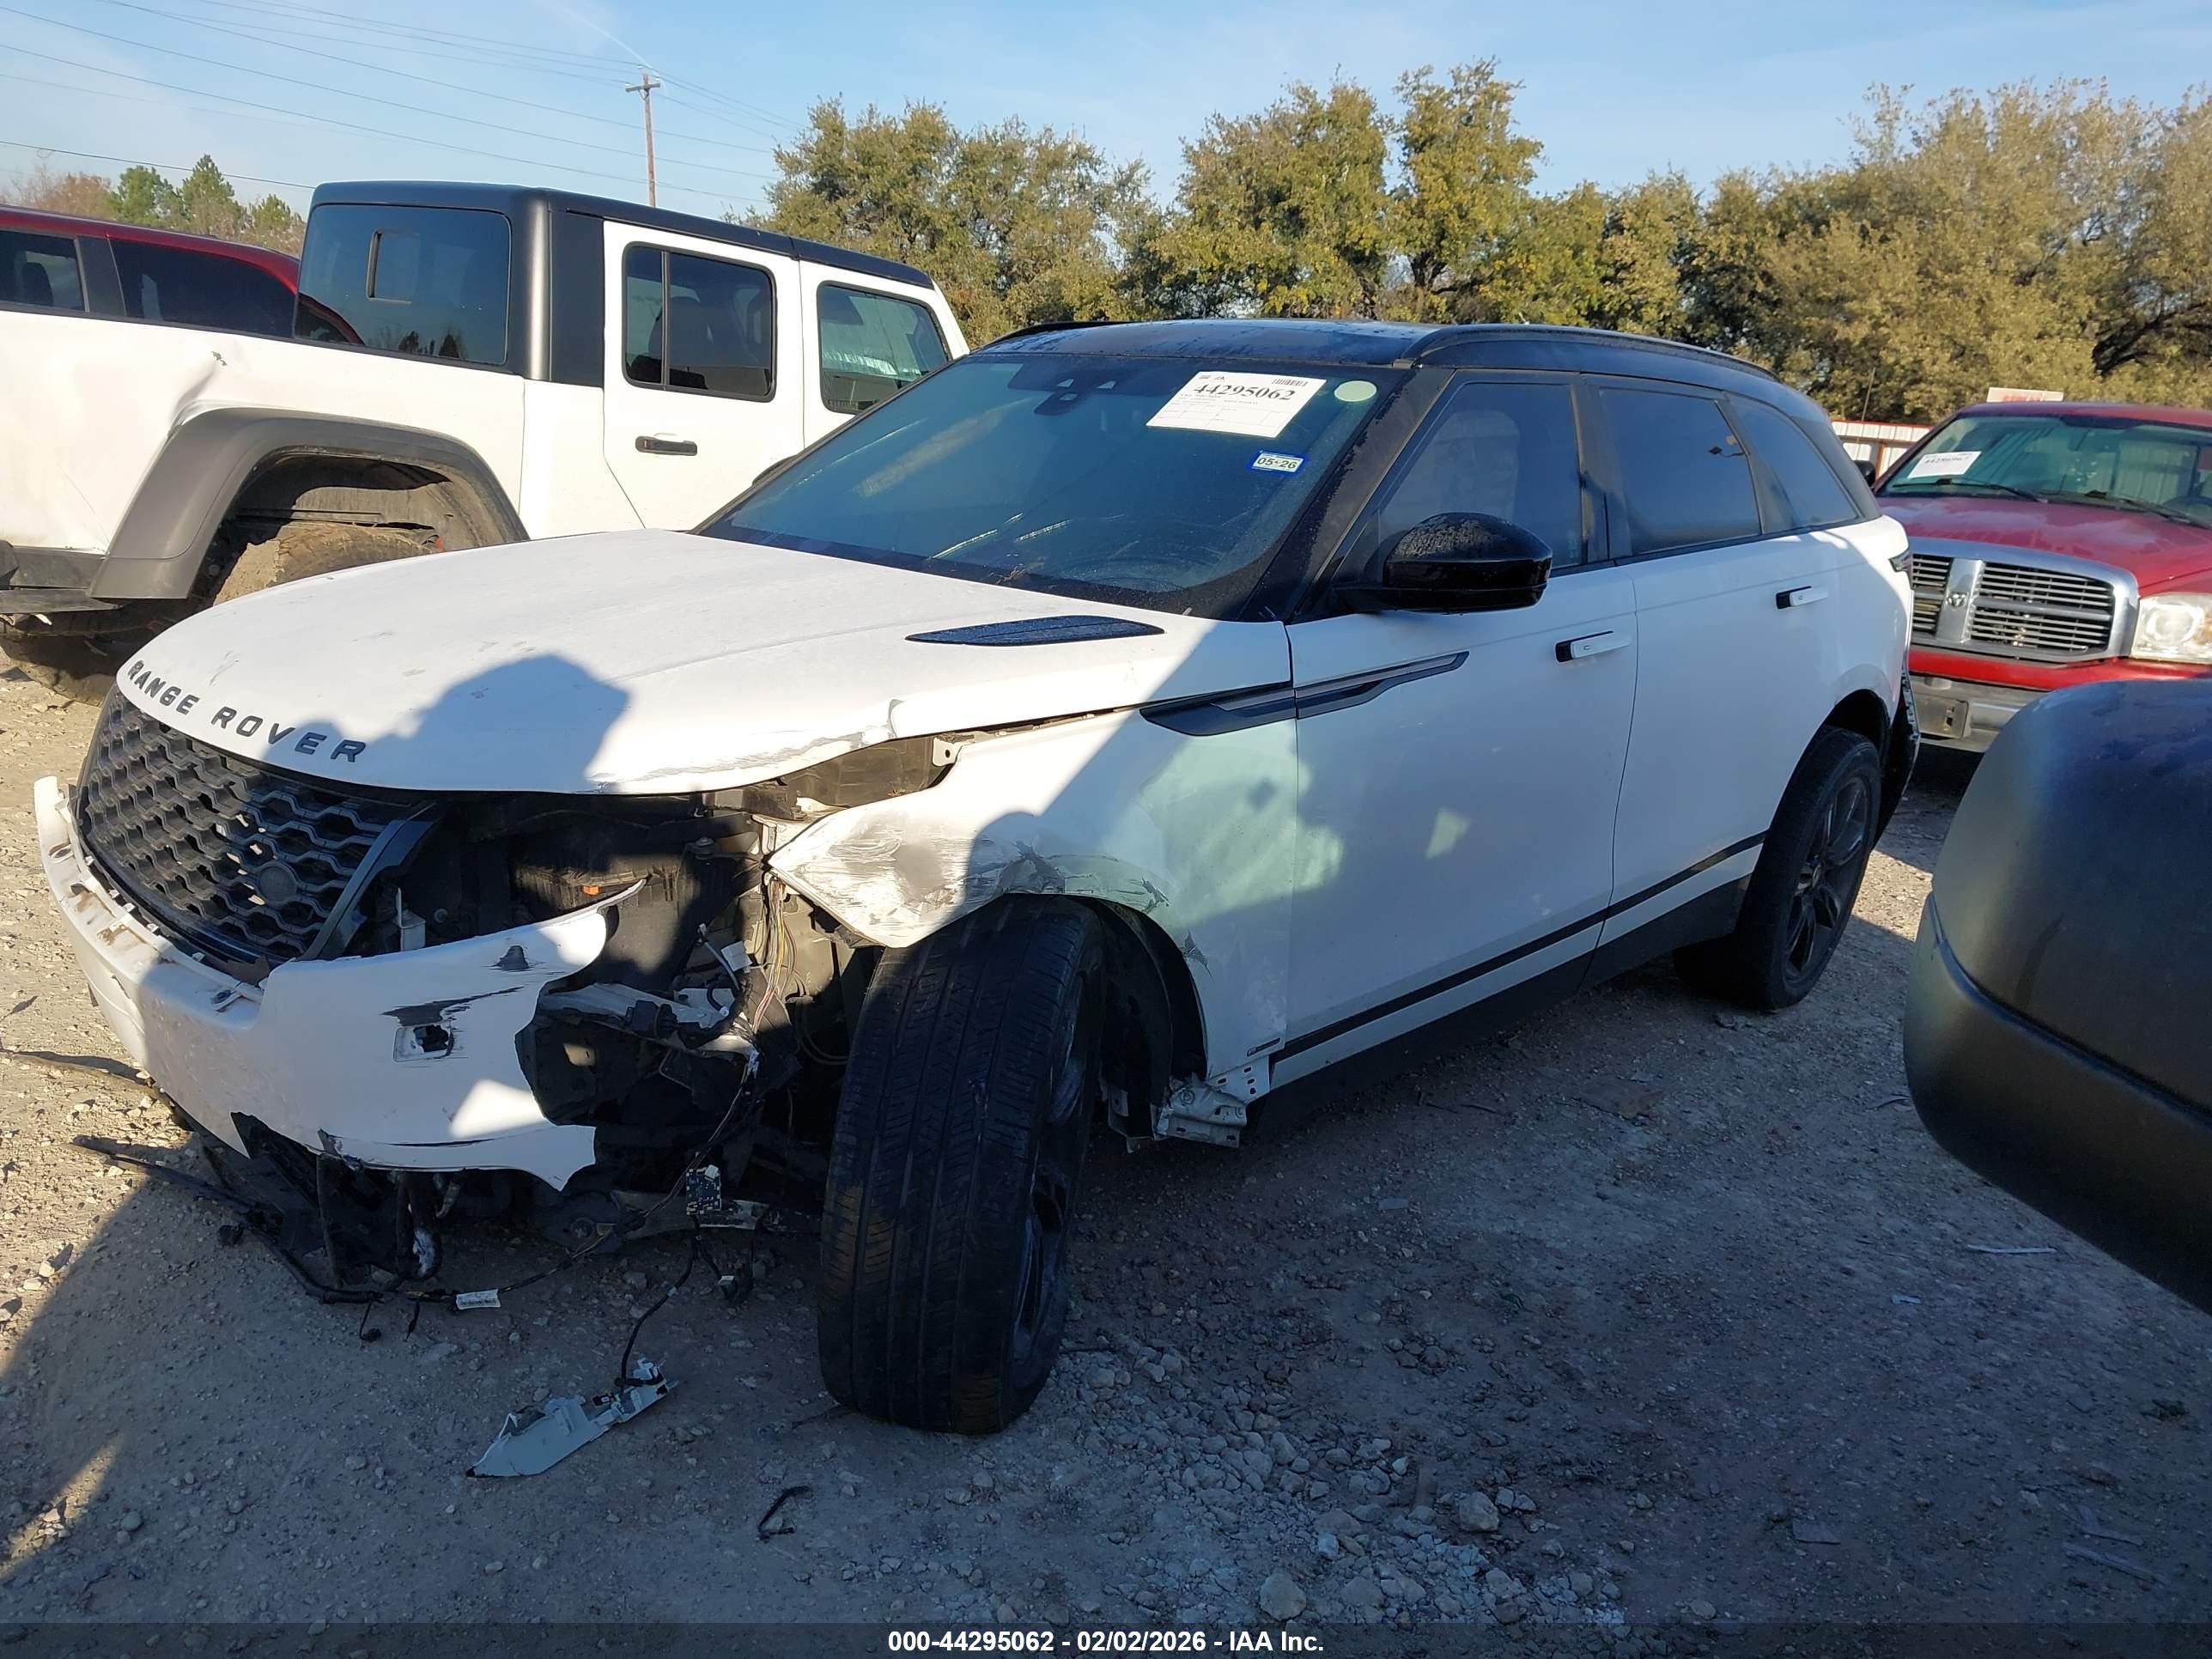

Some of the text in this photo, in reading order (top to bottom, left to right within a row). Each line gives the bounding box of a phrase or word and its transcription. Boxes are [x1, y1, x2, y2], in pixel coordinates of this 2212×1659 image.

[1194, 383, 1296, 401] 44295062
[127, 659, 367, 763] RANGE ROVER
